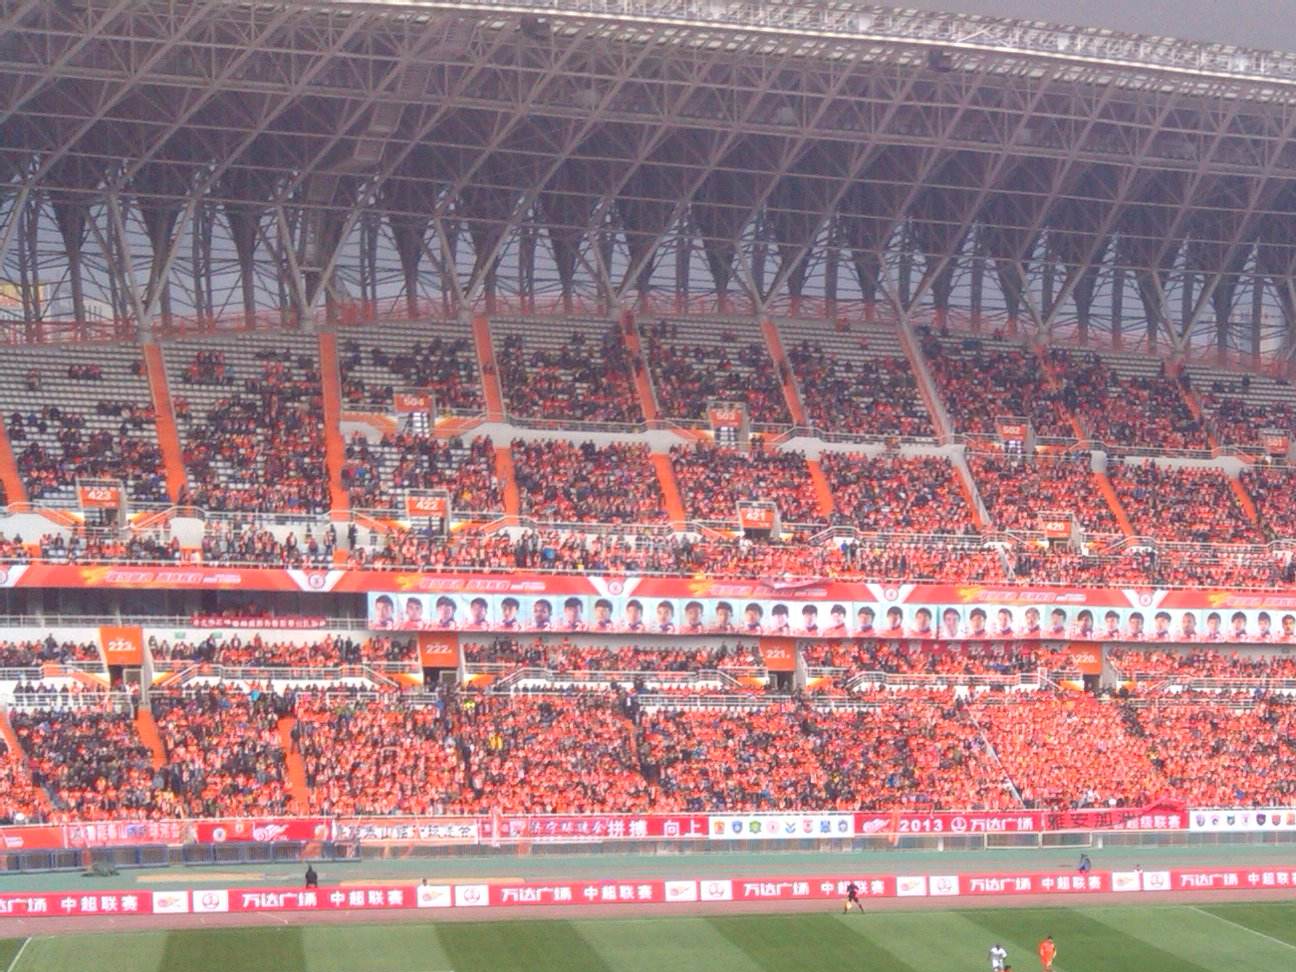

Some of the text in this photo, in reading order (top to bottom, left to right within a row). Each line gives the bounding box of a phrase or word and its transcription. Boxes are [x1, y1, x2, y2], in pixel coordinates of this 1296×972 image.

[88, 490, 112, 500] 423
[416, 501, 438, 510] 422
[900, 818, 944, 833] 2013
